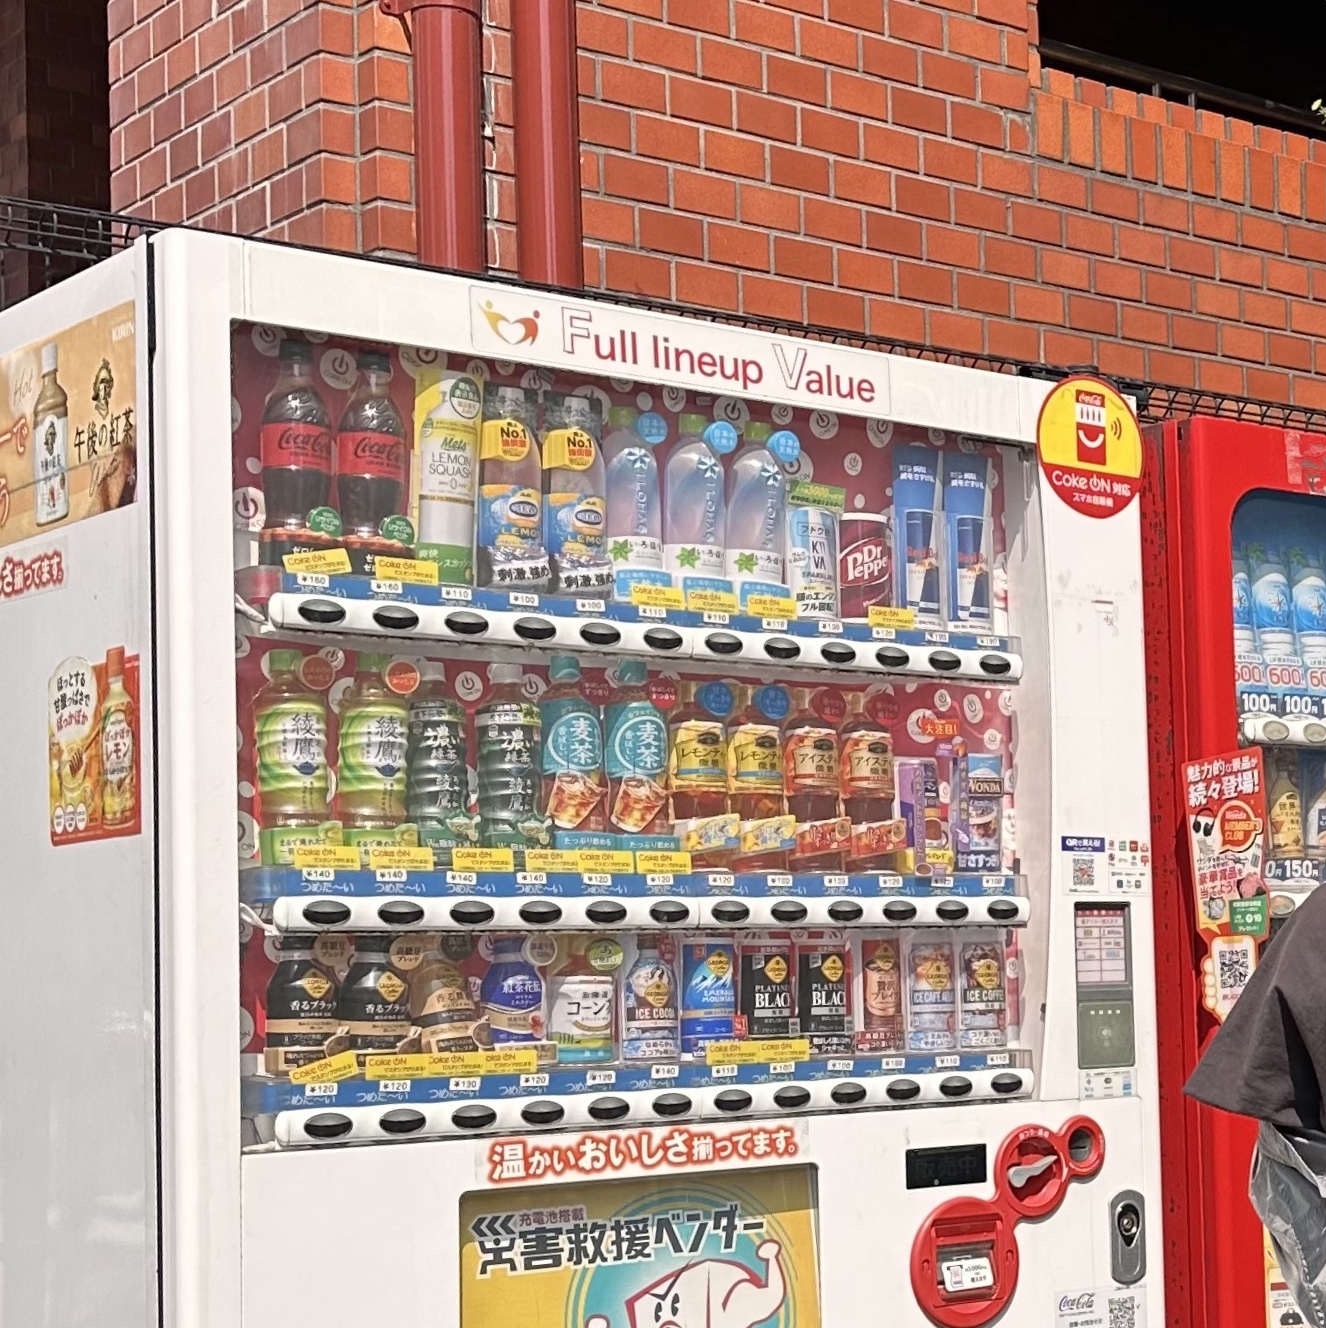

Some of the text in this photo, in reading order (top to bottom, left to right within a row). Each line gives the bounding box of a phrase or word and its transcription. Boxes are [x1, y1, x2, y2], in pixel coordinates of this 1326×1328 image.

[561, 306, 876, 403] Full lineup Value
[74, 406, 135, 465] 午後の紅茶
[1052, 470, 1087, 490] Coke
[1112, 482, 1132, 497] 対応
[862, 544, 883, 560] Dr
[847, 551, 888, 581] Peppe
[1242, 693, 1277, 712] 100円
[1284, 695, 1319, 714] 100円
[292, 713, 316, 761] 綾鷹
[375, 715, 399, 763] 綾鷹
[424, 723, 461, 748] 濃い
[501, 728, 535, 750] 濃い
[570, 717, 593, 765] 麦茶
[636, 722, 660, 768] 麦茶
[1187, 755, 1258, 783] 魅力的な景品が
[969, 778, 1001, 793] WONDA
[1188, 769, 1260, 808] 続々登場!
[296, 849, 321, 857] Coke
[372, 850, 395, 858] Coke
[456, 851, 478, 859] Coke
[307, 871, 331, 879] ¥140
[379, 871, 403, 879] ¥140
[1284, 859, 1319, 878] 150円
[966, 989, 980, 1001] ICE
[635, 1008, 651, 1019] ICE
[369, 1058, 391, 1067] Coke
[310, 1086, 334, 1094] ¥120
[383, 1082, 408, 1091] ¥120
[491, 1128, 797, 1180] 温かいおいしさ揃ってます。
[518, 1207, 585, 1226] 充電池搭載
[472, 1204, 765, 1275] 災害救援ベンダー
[1059, 1292, 1096, 1312] Coca-Cola
